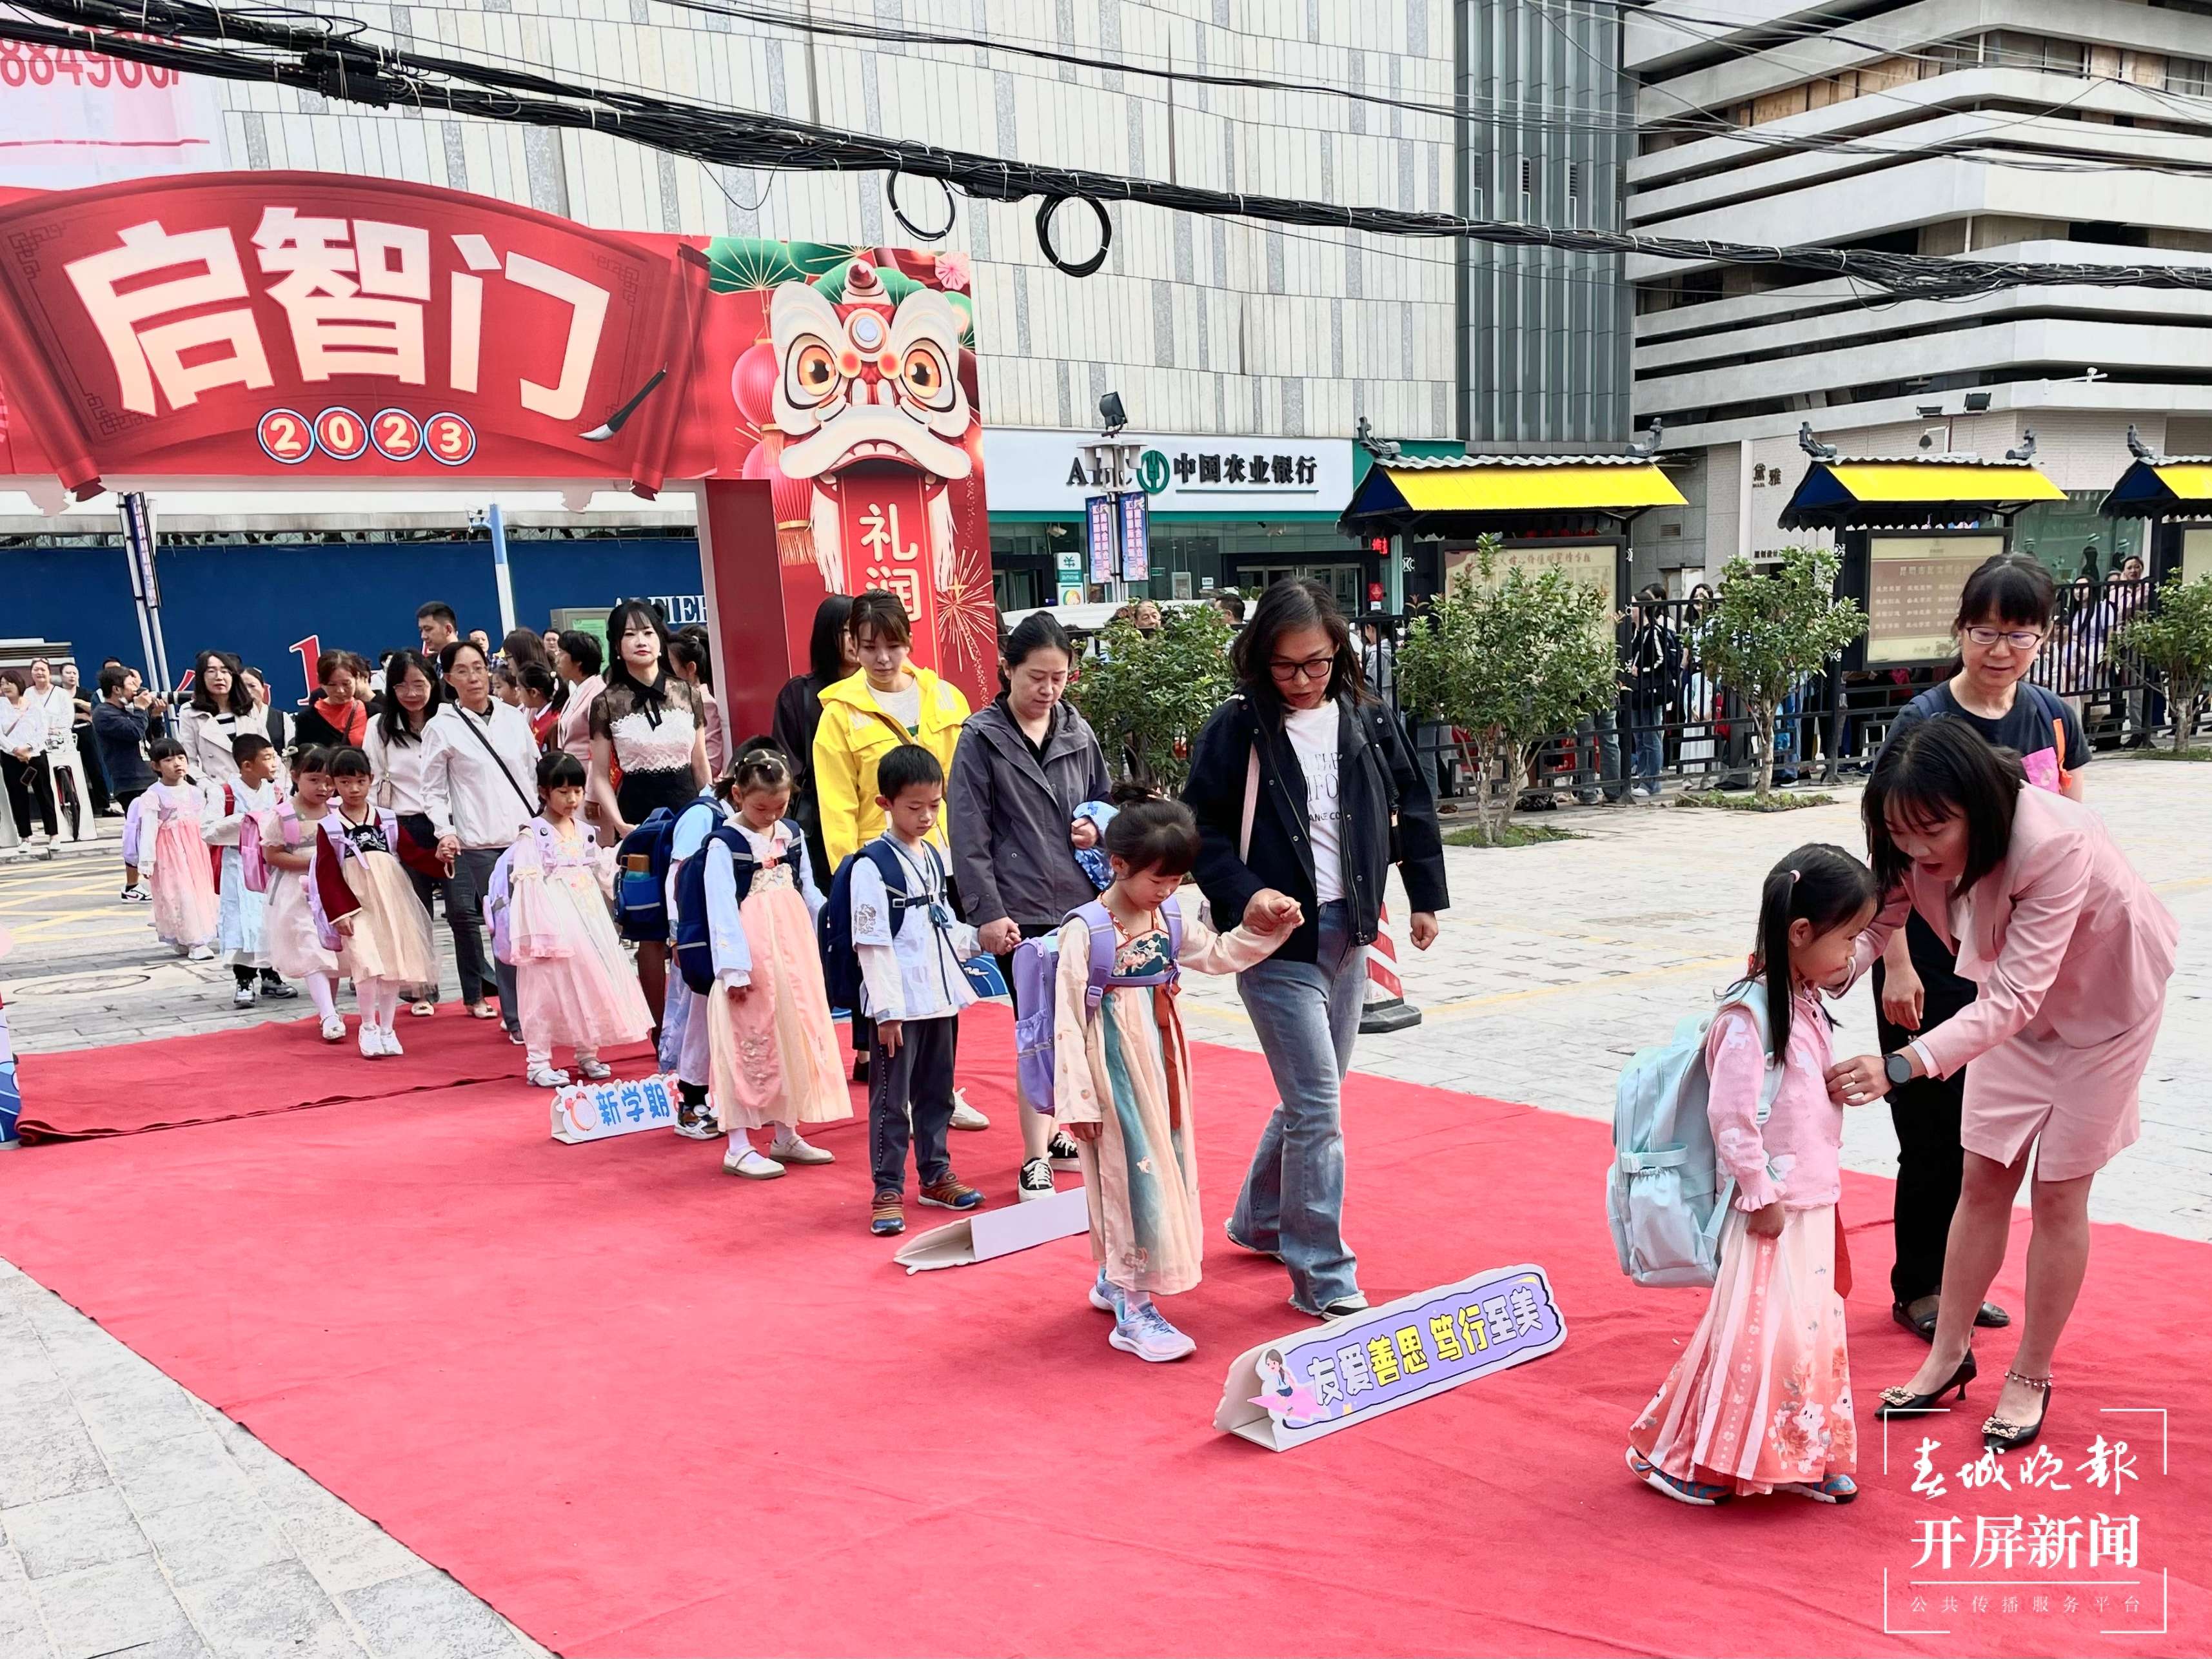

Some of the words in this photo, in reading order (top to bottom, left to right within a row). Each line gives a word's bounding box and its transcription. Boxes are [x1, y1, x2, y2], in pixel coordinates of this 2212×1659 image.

[64, 206, 611, 420] 启智门
[267, 415, 466, 453] 2023
[1173, 453, 1318, 484] 中国农业银行
[1307, 1324, 1429, 1406] 友爱善思
[1428, 1286, 1544, 1362] 笃行至美
